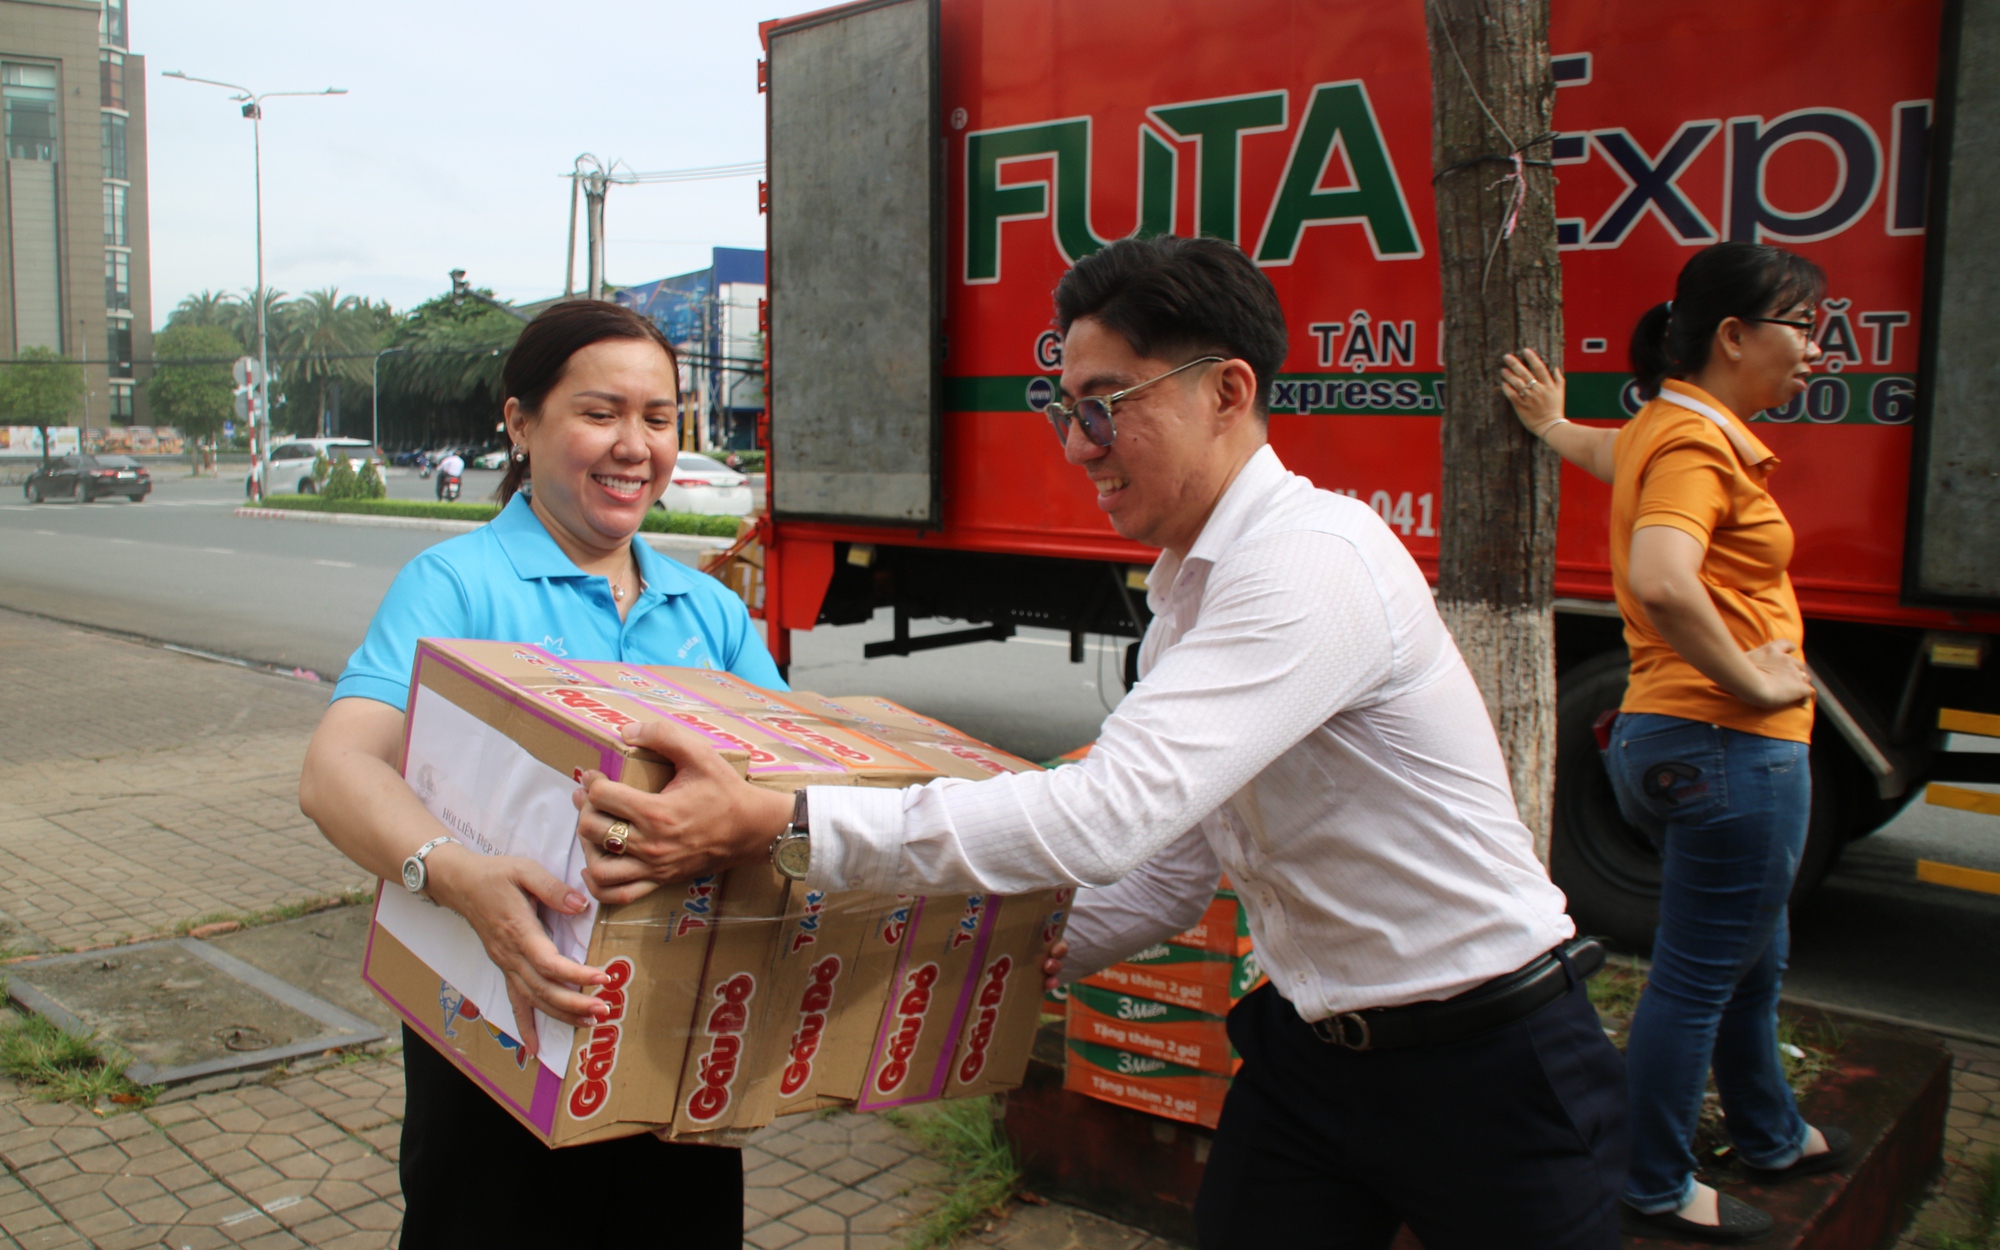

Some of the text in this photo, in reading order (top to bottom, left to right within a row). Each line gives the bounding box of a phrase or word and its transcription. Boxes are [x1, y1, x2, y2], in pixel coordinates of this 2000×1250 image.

[963, 79, 1424, 285] FUTA
[1309, 309, 1416, 373] TẬN
[1808, 298, 1910, 373] ẶT
